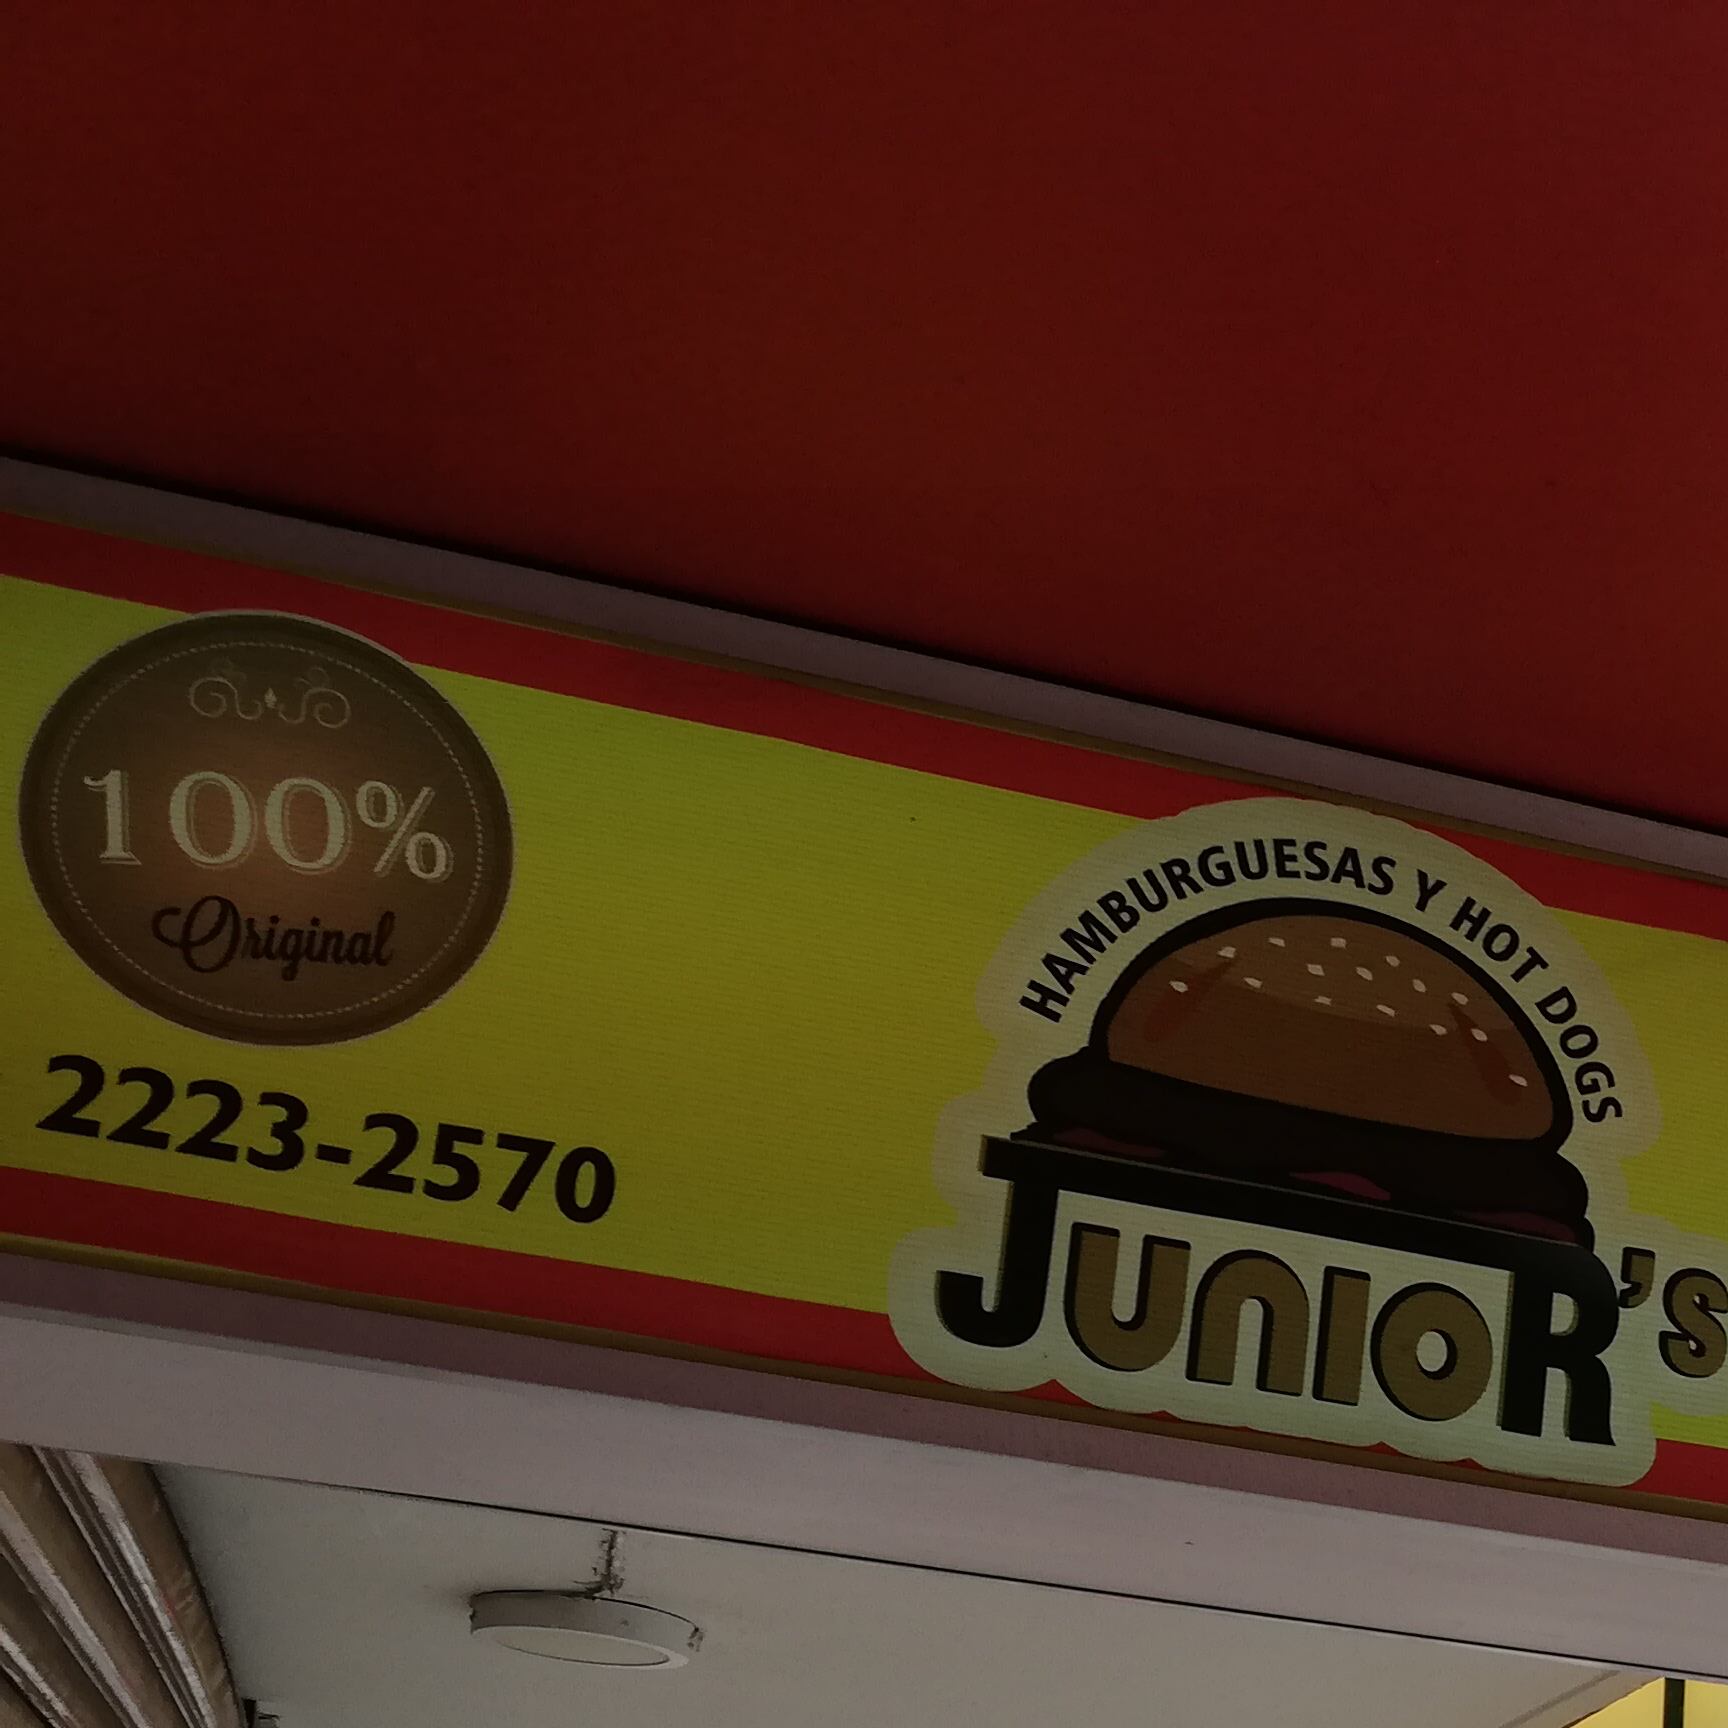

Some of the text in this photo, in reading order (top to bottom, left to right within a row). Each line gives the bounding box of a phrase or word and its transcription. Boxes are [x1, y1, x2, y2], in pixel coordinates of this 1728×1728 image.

[83, 769, 454, 881] 100%
[152, 895, 396, 981] Original
[1018, 838, 1624, 1125] HAMBURGUESAS Y HOT DOGS
[36, 1053, 618, 1225] 2223-2570
